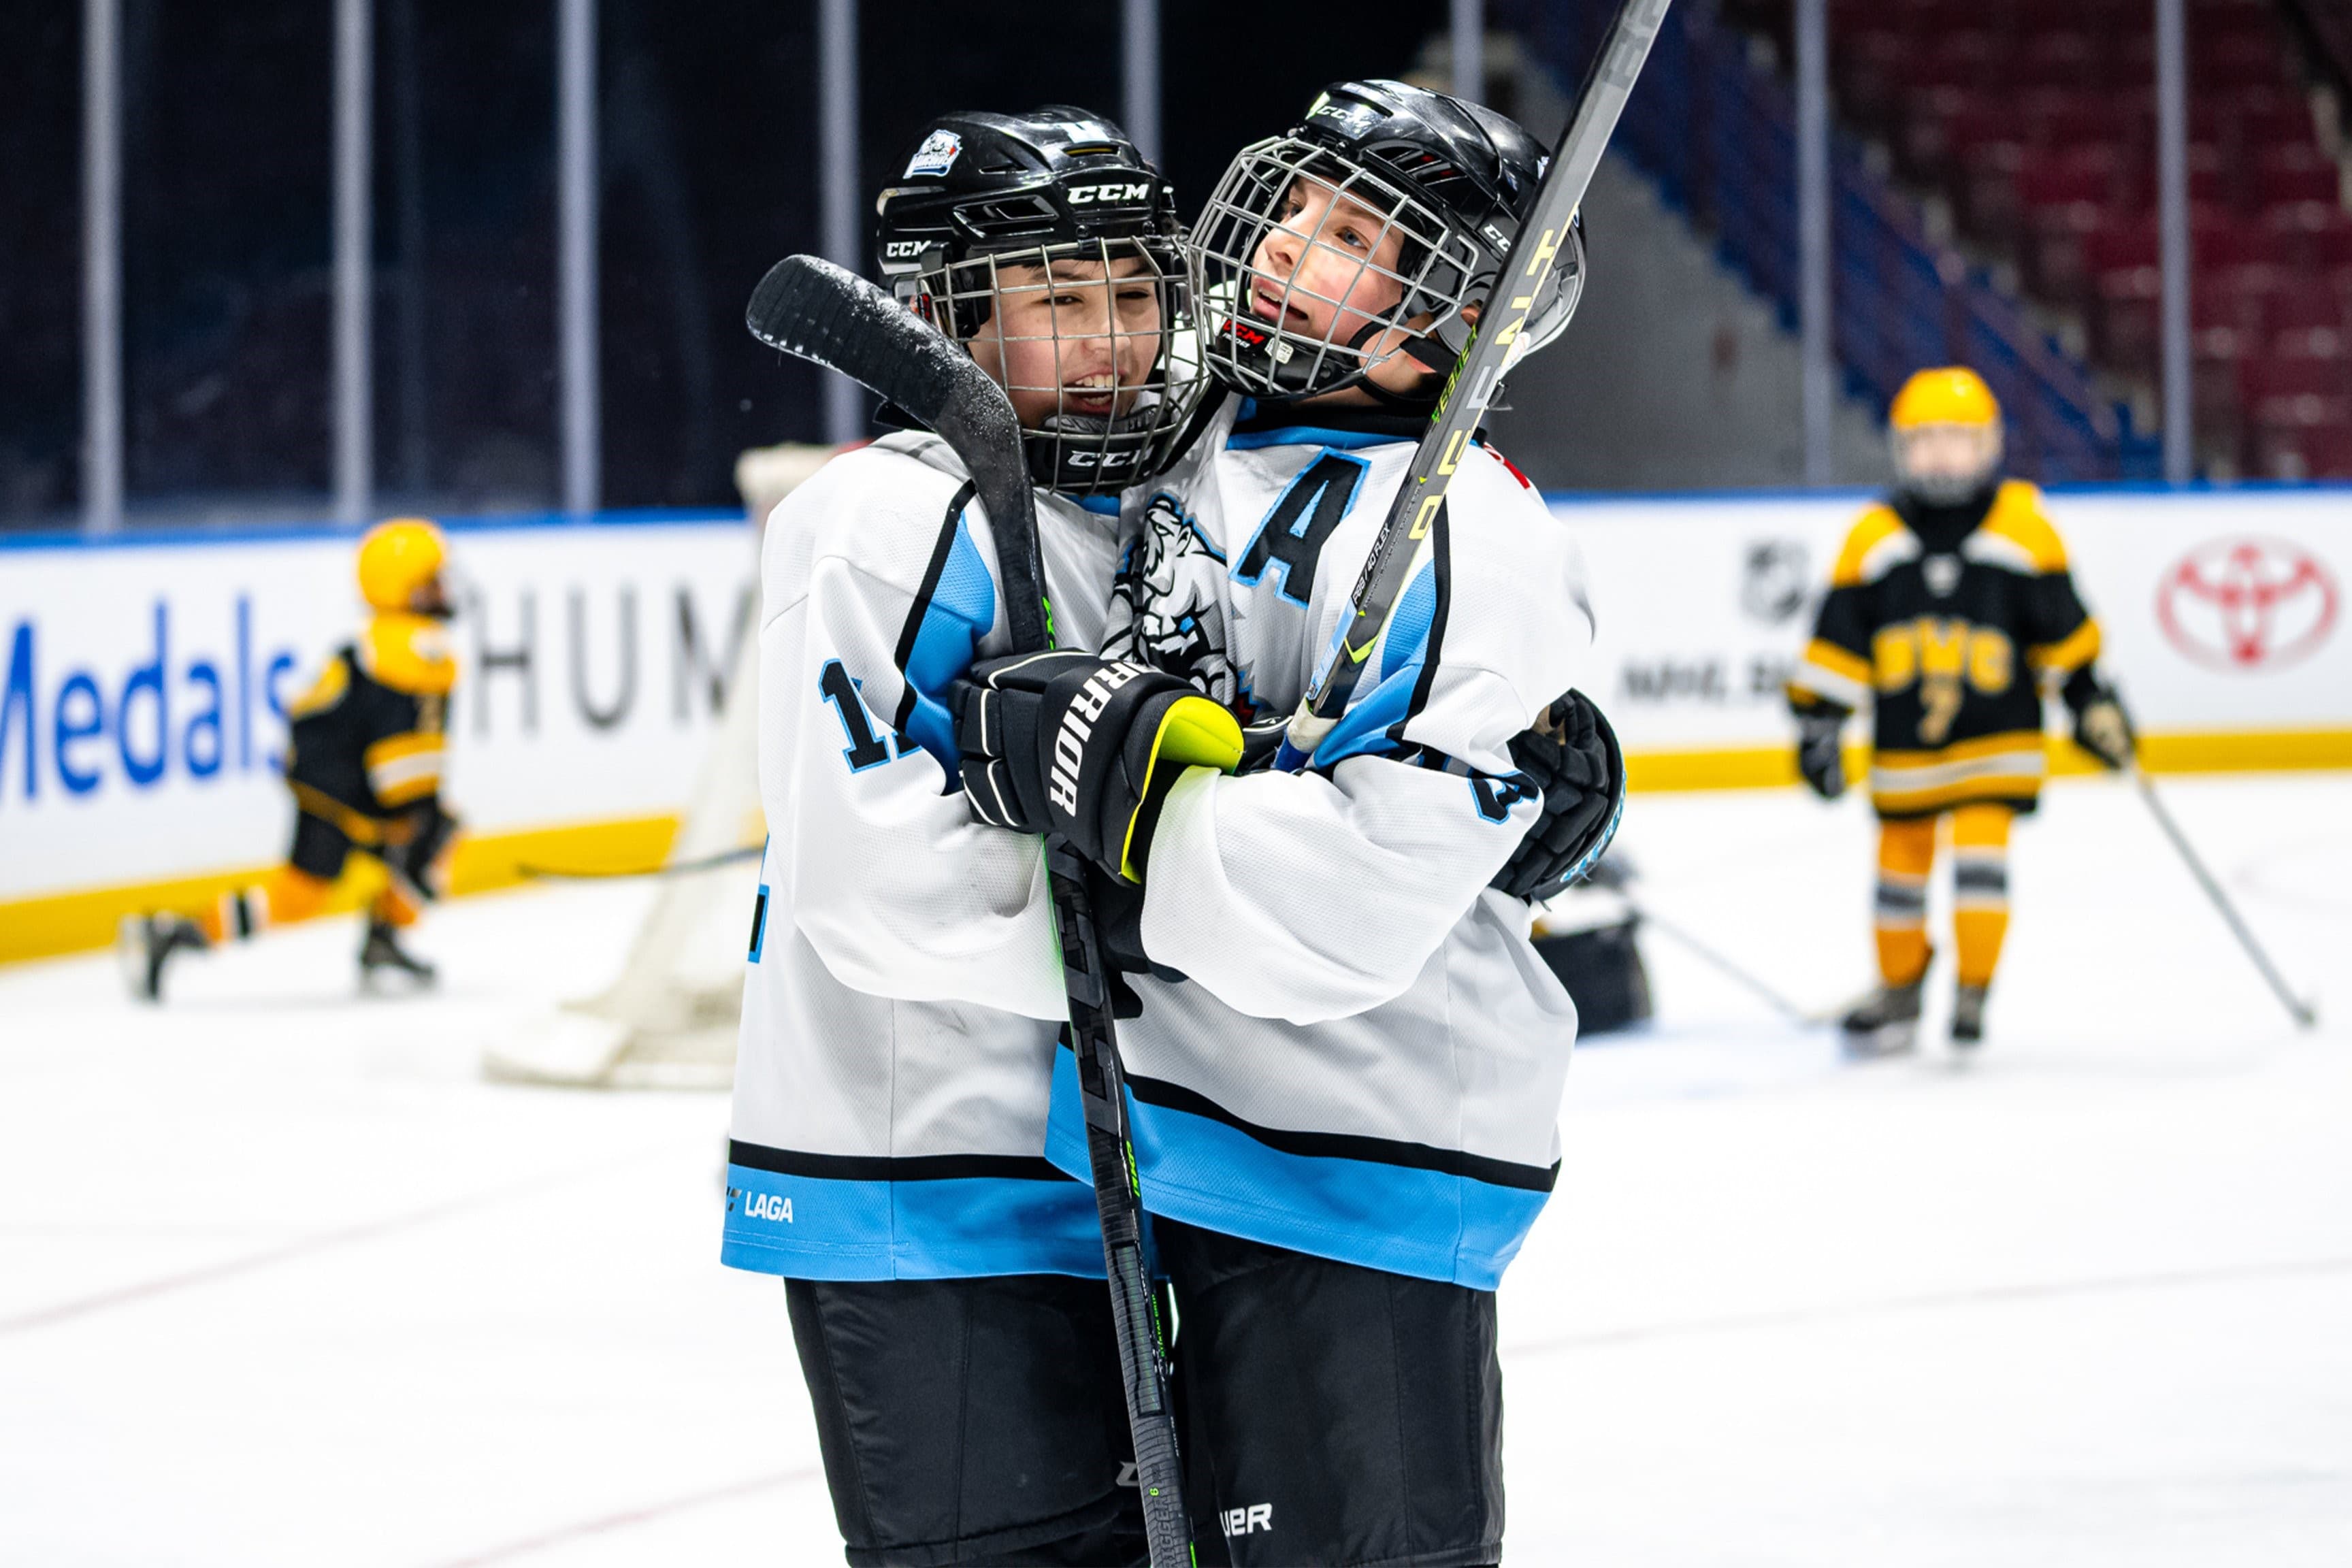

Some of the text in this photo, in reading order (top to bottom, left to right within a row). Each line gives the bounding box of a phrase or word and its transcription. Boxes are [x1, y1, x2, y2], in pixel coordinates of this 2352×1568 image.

[1067, 183, 1149, 204] CCM
[1483, 223, 1512, 252] CC
[1228, 446, 1371, 609] A
[1375, 523, 1390, 554] FLEX
[819, 658, 924, 774] 1
[1050, 662, 1164, 817] RRIOR
[745, 1190, 794, 1224] LAGA
[1149, 1487, 1160, 1497] 6
